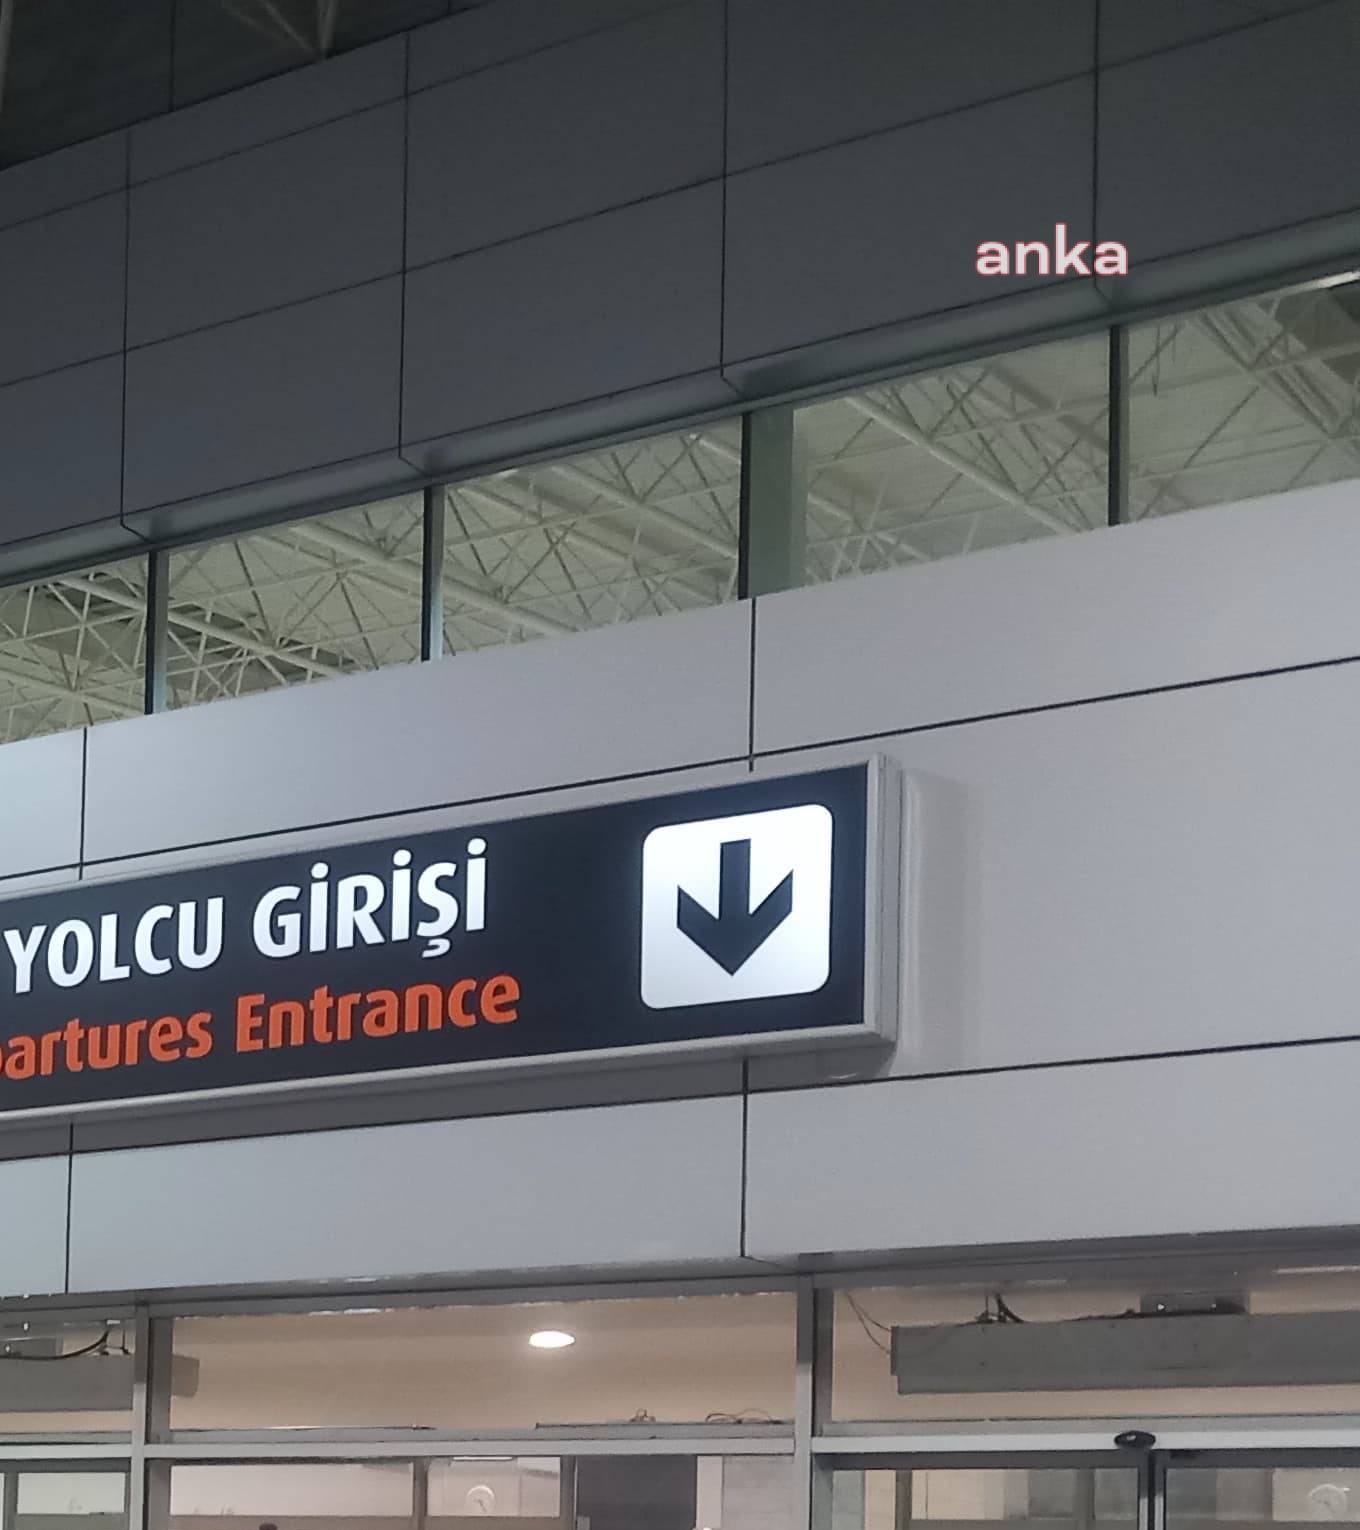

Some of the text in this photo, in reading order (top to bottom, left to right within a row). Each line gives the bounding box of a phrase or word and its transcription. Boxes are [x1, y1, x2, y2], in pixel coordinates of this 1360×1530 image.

[2, 896, 225, 995] YOLCU
[252, 837, 487, 958] GİRİŞİ
[235, 973, 521, 1054] Entrance
